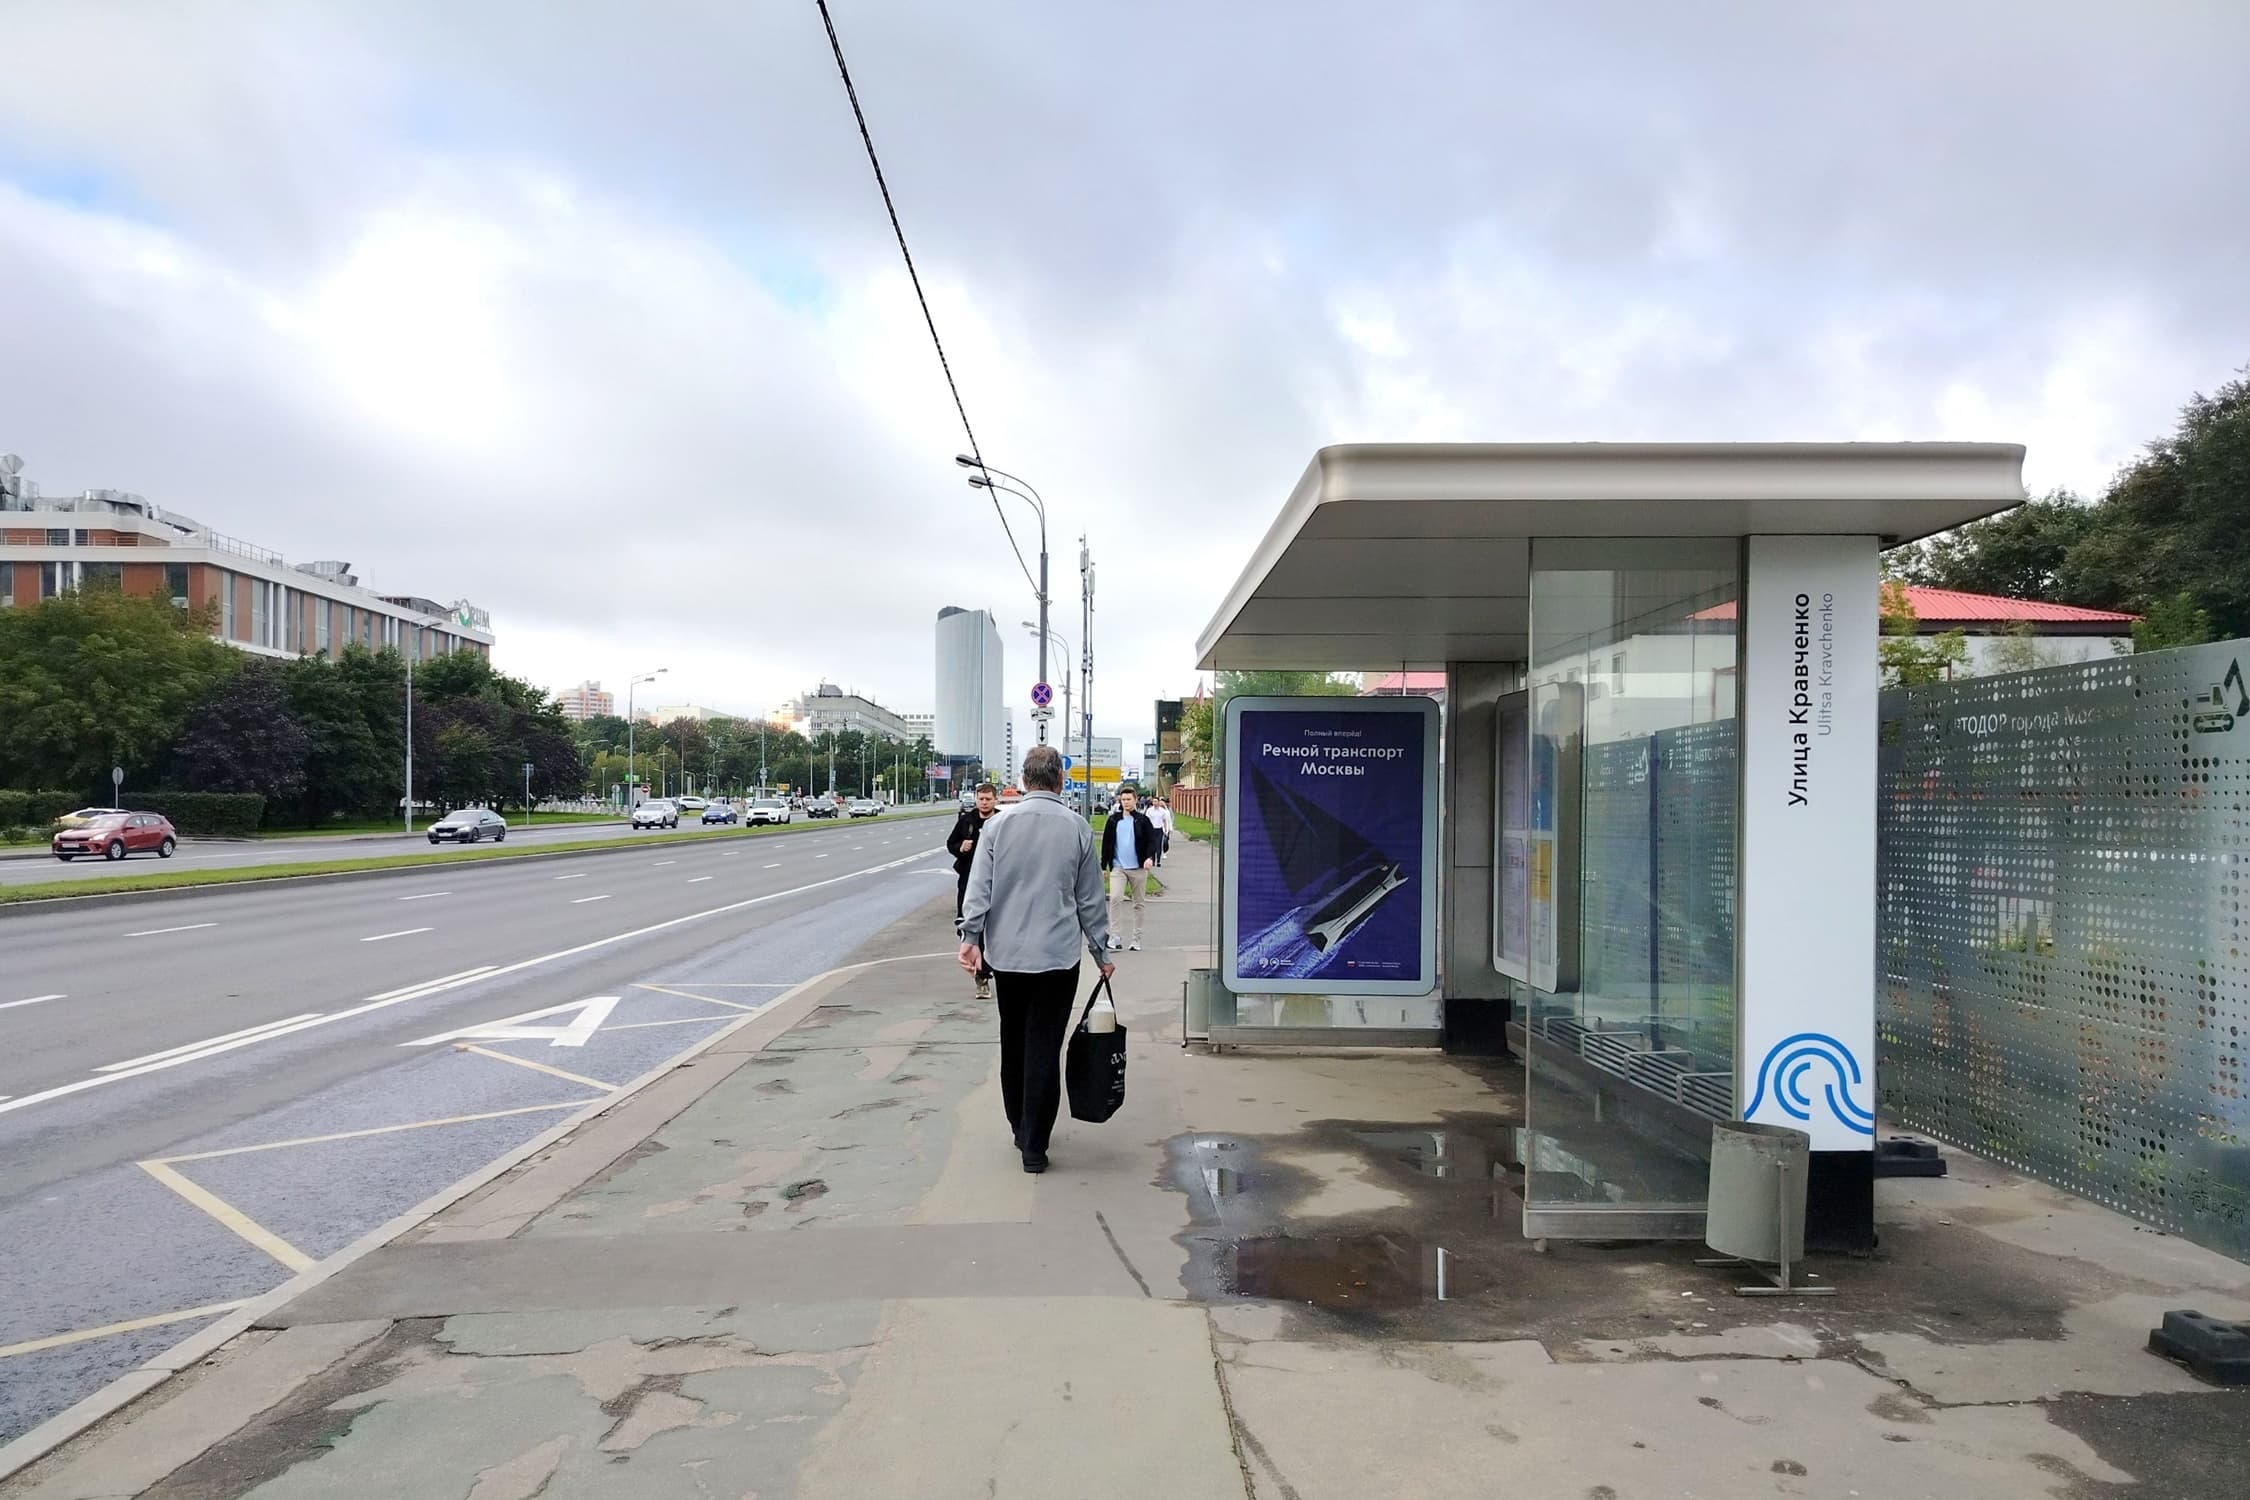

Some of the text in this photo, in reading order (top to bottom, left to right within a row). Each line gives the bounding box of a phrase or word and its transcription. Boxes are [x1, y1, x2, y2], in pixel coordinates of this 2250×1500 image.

[1818, 592, 1833, 736] Ulitsa Kravchenko
[1788, 593, 1812, 806] Улица Кравченко
[1304, 729, 1362, 739] Полный вперёд!
[2011, 711, 2059, 736] города
[1262, 743, 1405, 760] Речной транспорт
[1301, 762, 1365, 776] Москвы
